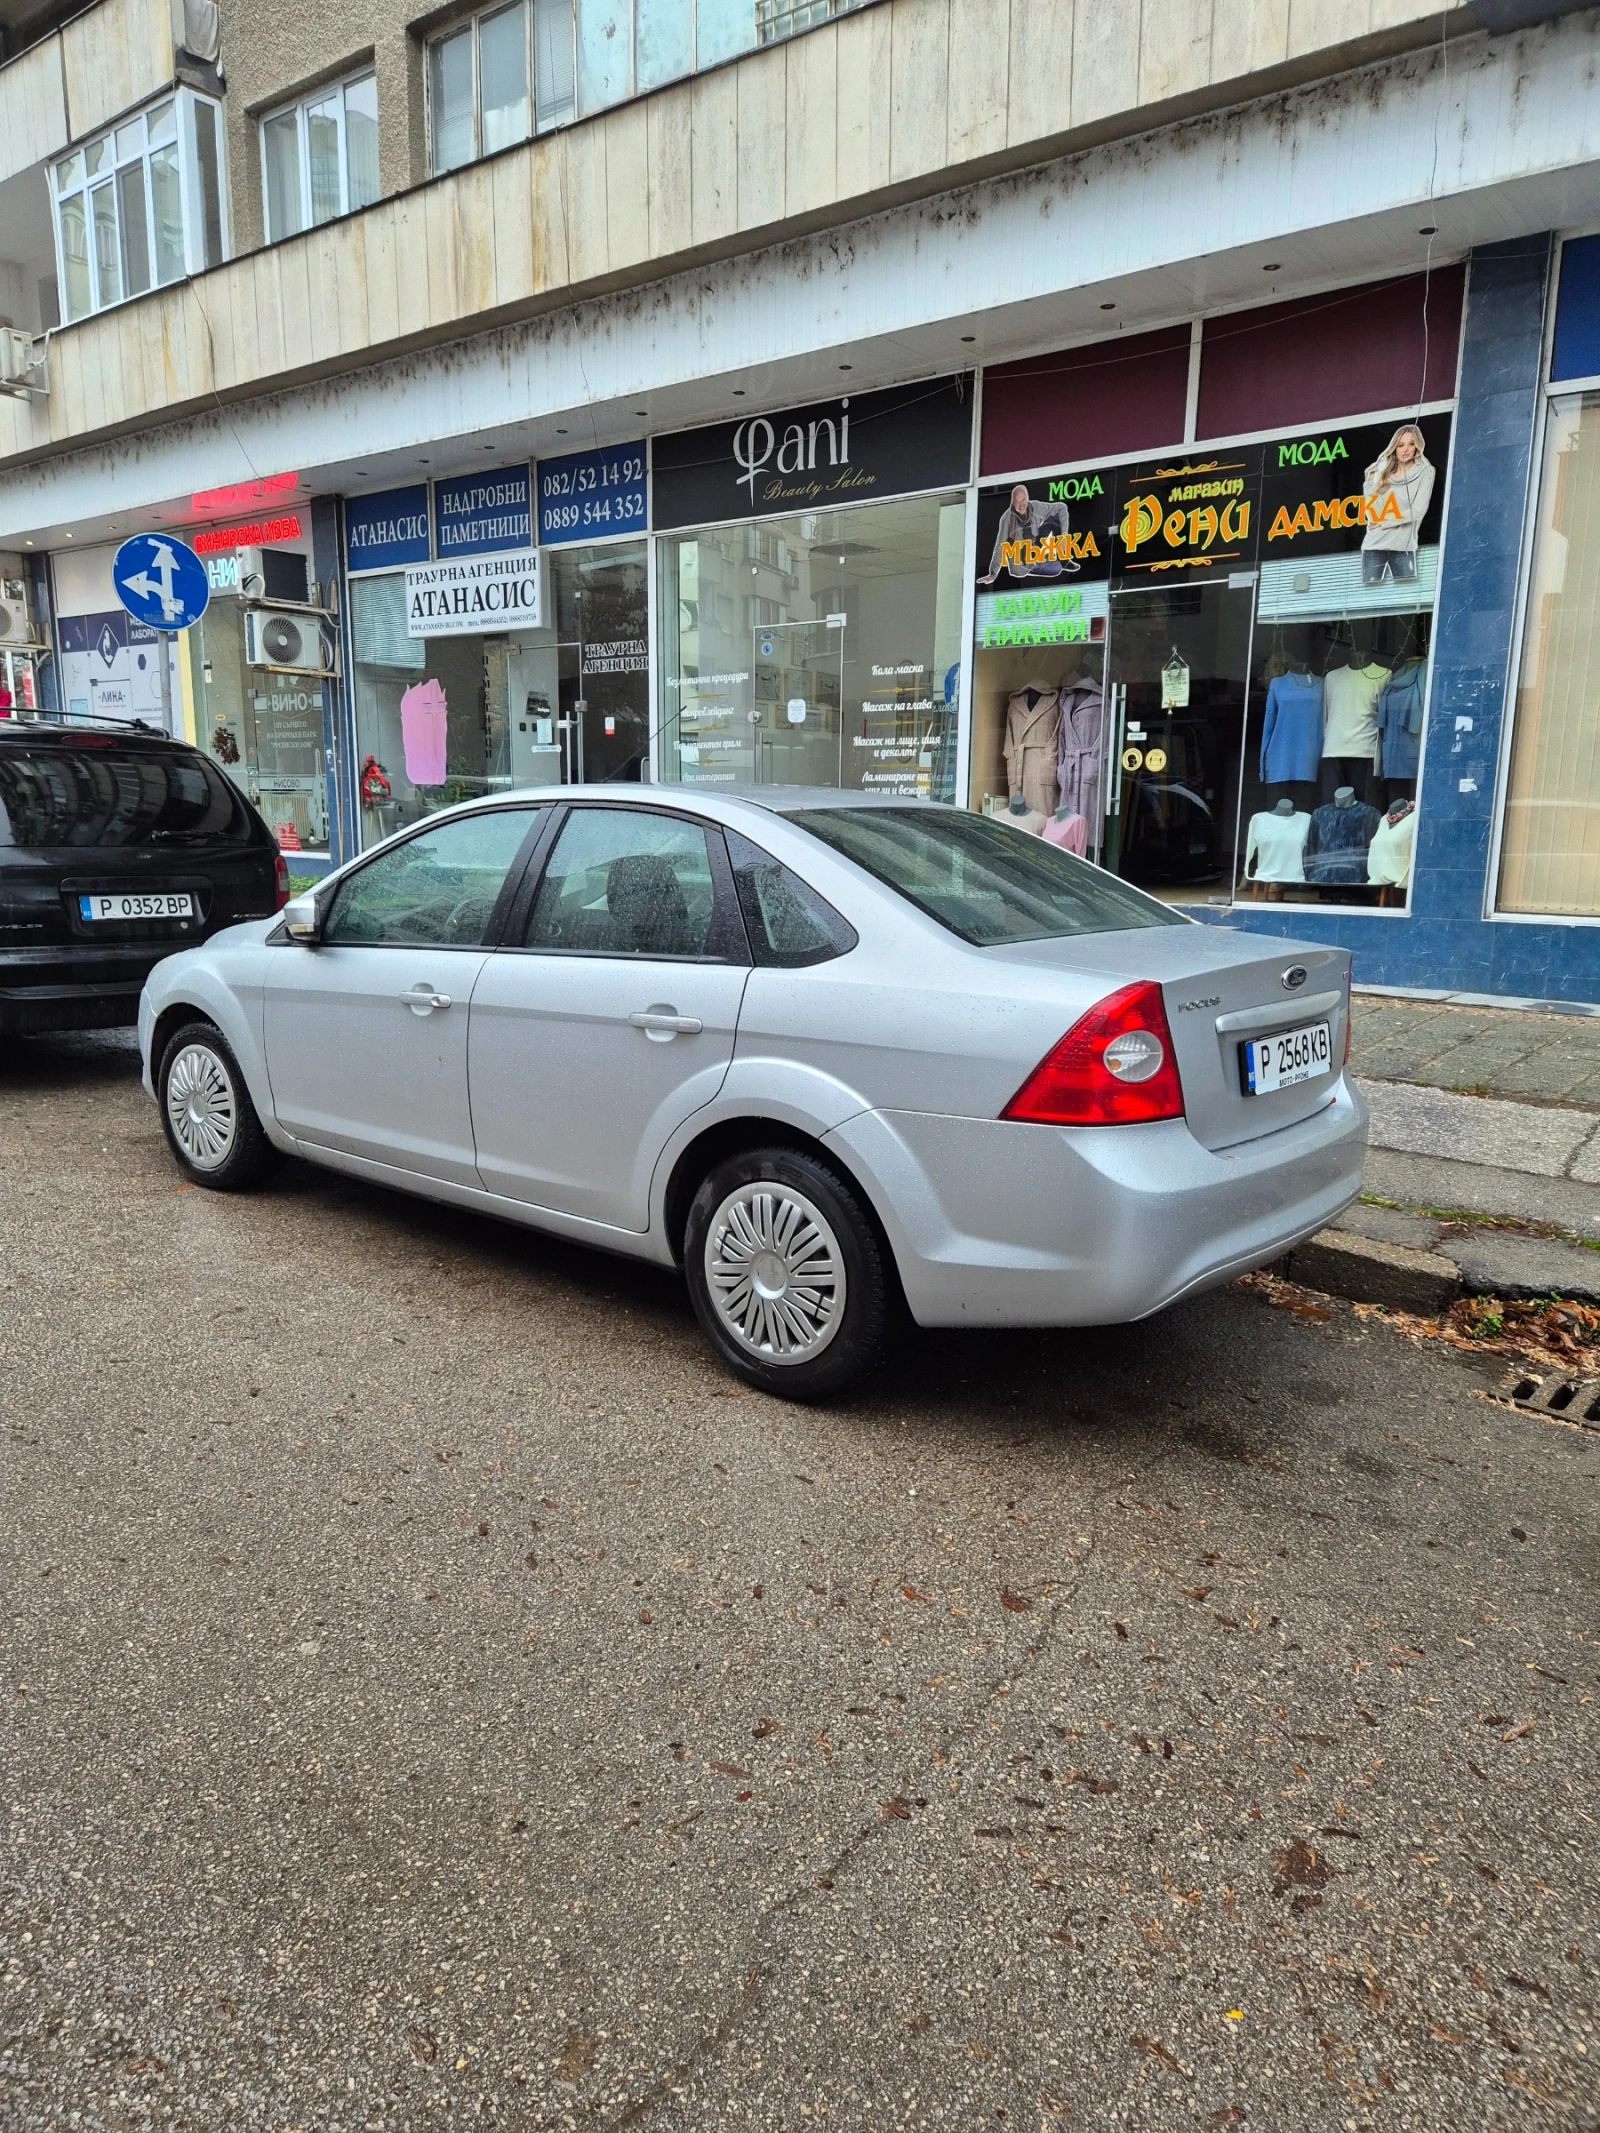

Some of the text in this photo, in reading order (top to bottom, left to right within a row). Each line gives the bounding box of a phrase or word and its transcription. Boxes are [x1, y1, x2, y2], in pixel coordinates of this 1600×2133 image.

[1278, 437, 1349, 468] МОДА
[543, 458, 643, 497] 082/52 14 92
[763, 467, 877, 500] Beauty Salon
[1048, 475, 1104, 502] МОДА
[443, 481, 527, 517] НАДГРОБНИ
[544, 493, 644, 531] 0889 544 352
[350, 513, 428, 548] АТАНАСИС
[441, 513, 530, 546] ПАМЕТНИЦИ
[1267, 492, 1402, 542] ДАМСКА
[194, 516, 302, 554] ВИНАРСКА ИЗБА
[1000, 531, 1100, 567] МЪЖКА
[407, 557, 537, 586] ТРАУРНА АГЕНЦИЯ
[411, 578, 536, 618] АТАНАСИС
[985, 619, 1087, 648] ПИЖАМИ
[585, 640, 646, 658] ТРАУРНА
[583, 656, 649, 674] АГЕНЦИЯ
[872, 664, 924, 676] Кола маска
[101, 690, 124, 703] ЛИНА
[271, 692, 308, 712] ВИНО
[862, 701, 892, 712] Масаж
[894, 702, 905, 711] на
[906, 699, 933, 711] глава
[853, 736, 884, 746] Масаж
[885, 737, 895, 745] на
[880, 748, 917, 759] деколте
[273, 779, 300, 789] НИСОВО
[862, 771, 916, 783] Ламиниране
[100, 899, 112, 916] P
[121, 897, 164, 915] 0352
[167, 896, 189, 914] BP
[1178, 997, 1221, 1013] FOCUS
[1261, 1044, 1270, 1079] P
[1278, 1033, 1310, 1074] 2568
[1311, 1029, 1328, 1063] KB
